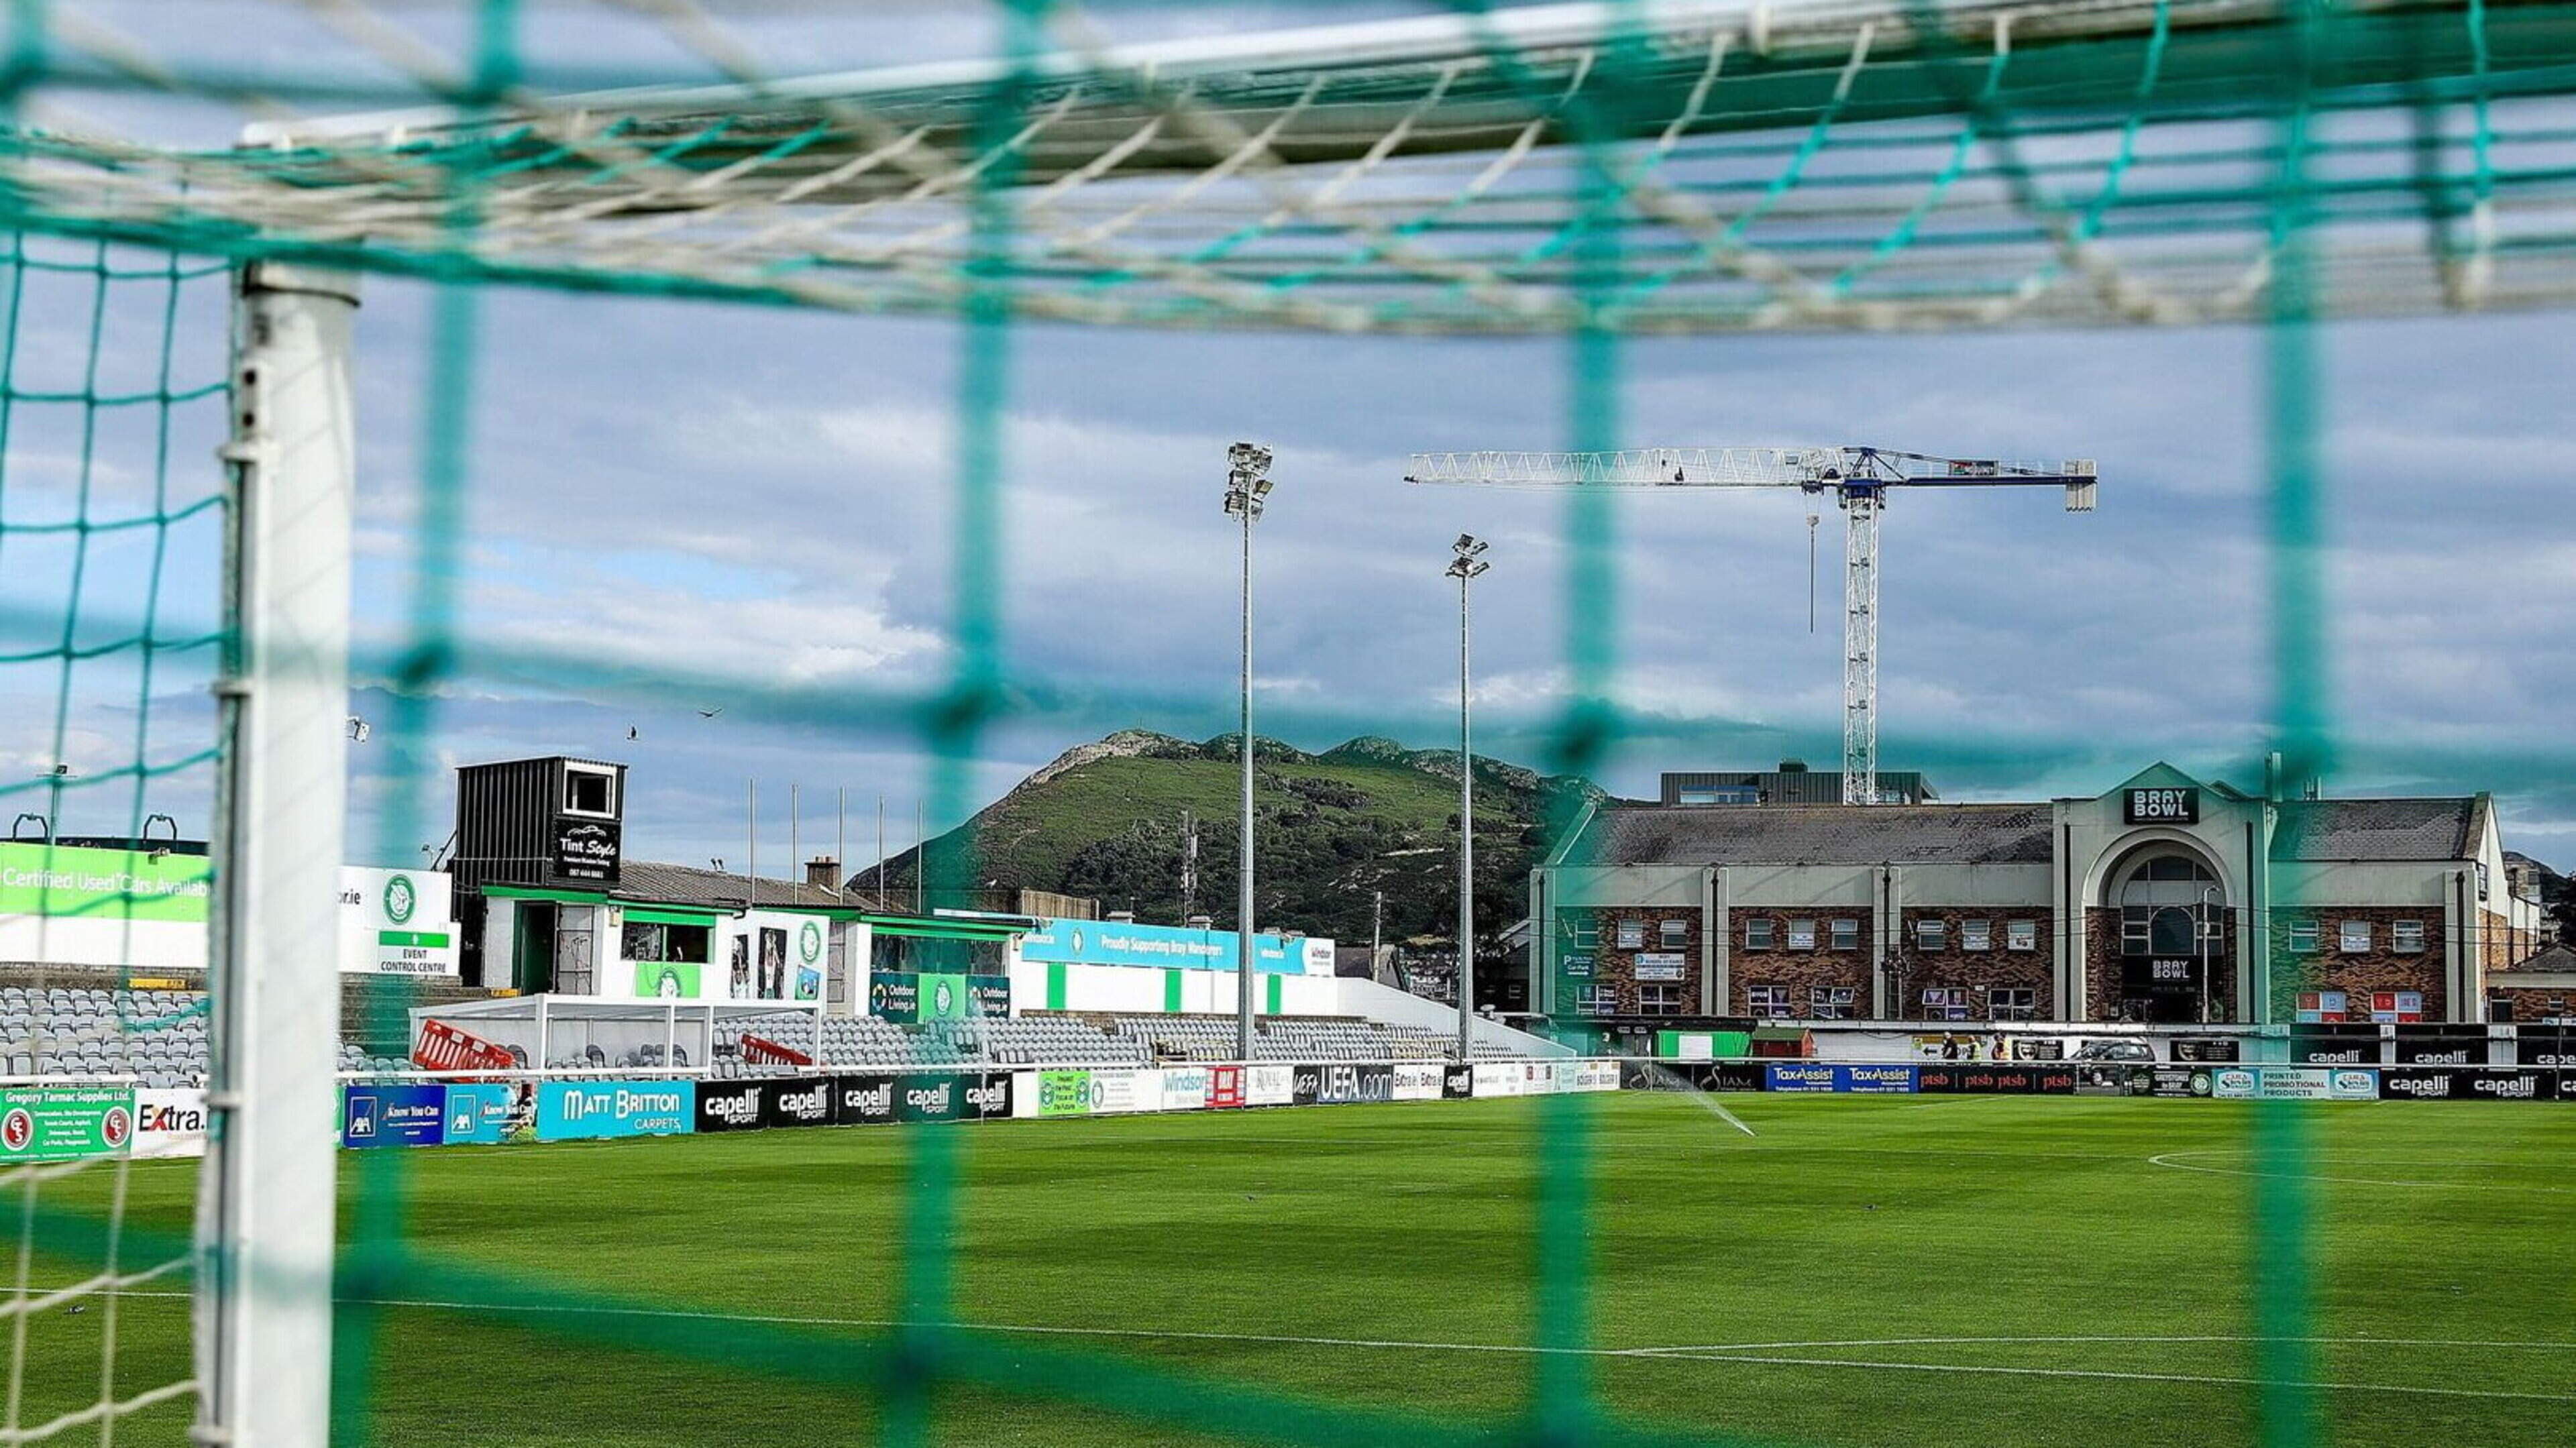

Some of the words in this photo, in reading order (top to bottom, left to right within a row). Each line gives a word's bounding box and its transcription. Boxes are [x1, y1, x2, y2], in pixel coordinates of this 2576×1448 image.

[2134, 790, 2186, 803] BRAY
[2134, 803, 2189, 816] BOWL
[559, 837, 584, 852] Tint
[586, 840, 616, 858] Style
[3, 868, 73, 889] Certified
[78, 873, 115, 891] Used
[119, 876, 153, 893] Cars
[156, 877, 212, 896] Availab
[1101, 934, 1130, 953] Proudly
[1130, 936, 1169, 956] Supporting
[403, 949, 427, 959] EVENT
[381, 961, 417, 972] CONTROL
[418, 962, 446, 973] CENTRE
[2153, 960, 2188, 970] BRAY
[2153, 970, 2190, 979] BOWL
[888, 984, 916, 997] Outdoor
[982, 987, 1008, 998] Outdoor
[888, 998, 916, 1013] Living.ie
[2309, 1050, 2360, 1064] capelli
[2415, 1050, 2467, 1064] capelli
[1700, 1066, 1752, 1091] SIAM
[1774, 1068, 1834, 1080] TaxAssist
[1849, 1068, 1911, 1080] TaxAssist
[1920, 1072, 1949, 1089] ptsb
[1965, 1073, 1993, 1089] ptsb
[1998, 1073, 2027, 1089] ptsb
[1321, 1066, 1393, 1100] UEFA.com
[2043, 1074, 2072, 1090] ptsb
[2389, 1076, 2450, 1095] capelli
[2473, 1076, 2535, 1095] capelli
[5, 1091, 42, 1105] Gregory
[44, 1091, 75, 1103] Tarmac
[76, 1091, 113, 1104] Supplies
[114, 1090, 131, 1101] Ltd.
[779, 1085, 827, 1118] capelli
[845, 1082, 892, 1113] capelli
[907, 1082, 949, 1111] capelli
[966, 1080, 1006, 1111] capelli
[388, 1107, 409, 1117] Know
[410, 1105, 424, 1117] You
[564, 1090, 611, 1119] MATT
[615, 1089, 680, 1119] BRITTON
[705, 1089, 760, 1121] capelli
[864, 1107, 891, 1116] SPORT
[925, 1105, 949, 1114] SPORT
[983, 1103, 1005, 1112] SPORT
[139, 1104, 205, 1131] Extra.
[729, 1113, 757, 1125] SPORT
[800, 1108, 826, 1119] SPORT
[634, 1119, 680, 1129] CARPETS
